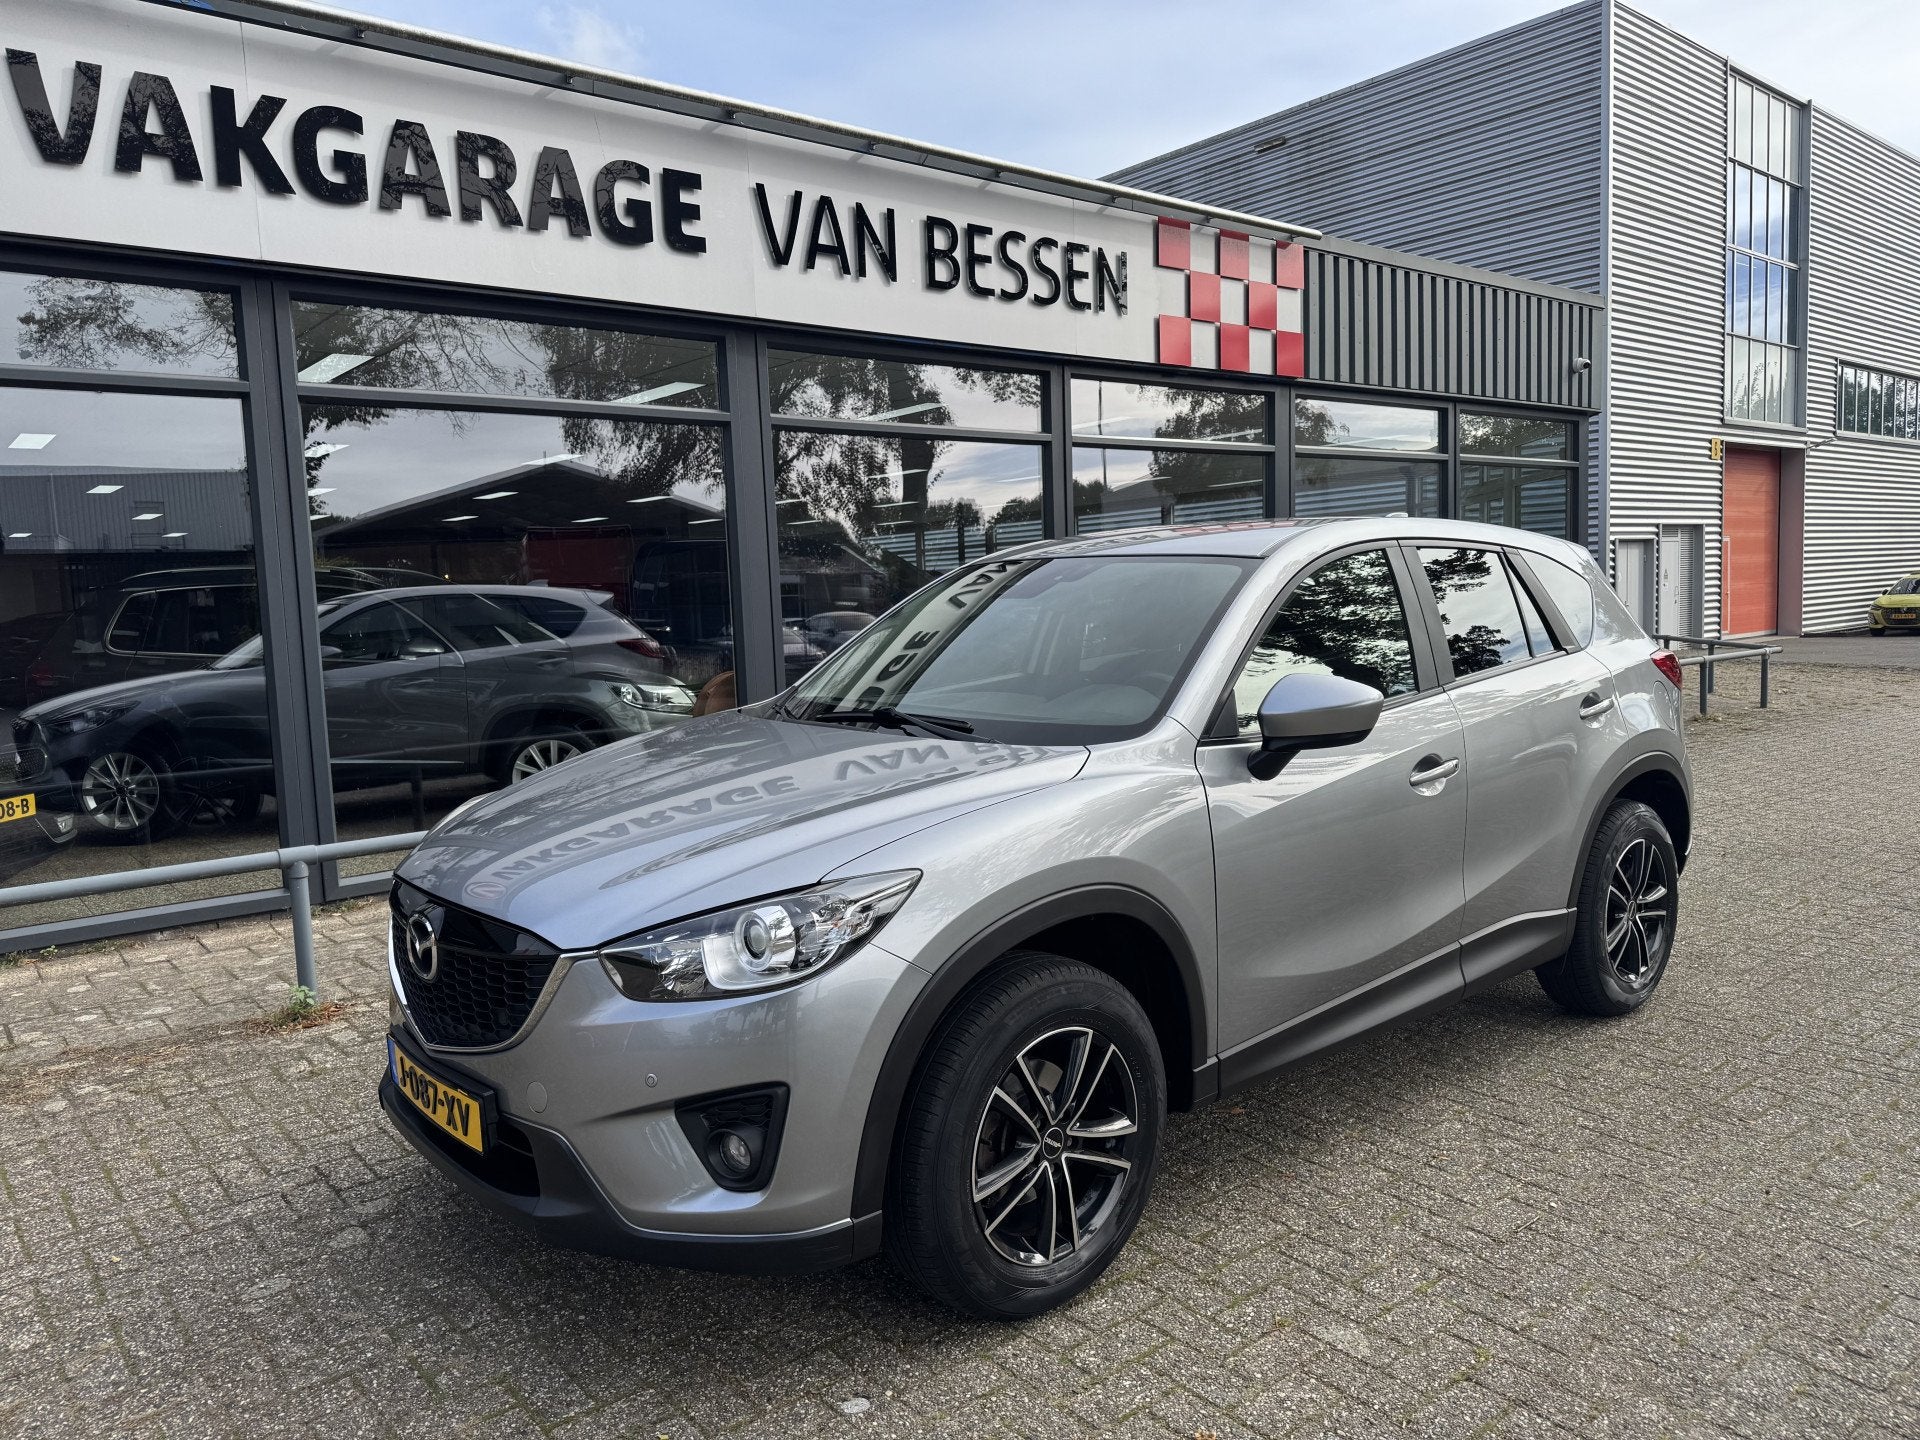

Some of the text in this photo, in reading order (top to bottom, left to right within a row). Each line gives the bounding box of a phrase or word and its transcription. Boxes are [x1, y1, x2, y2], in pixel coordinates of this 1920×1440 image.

[5, 47, 1128, 316] VAKGARAGE VAN BESSEN
